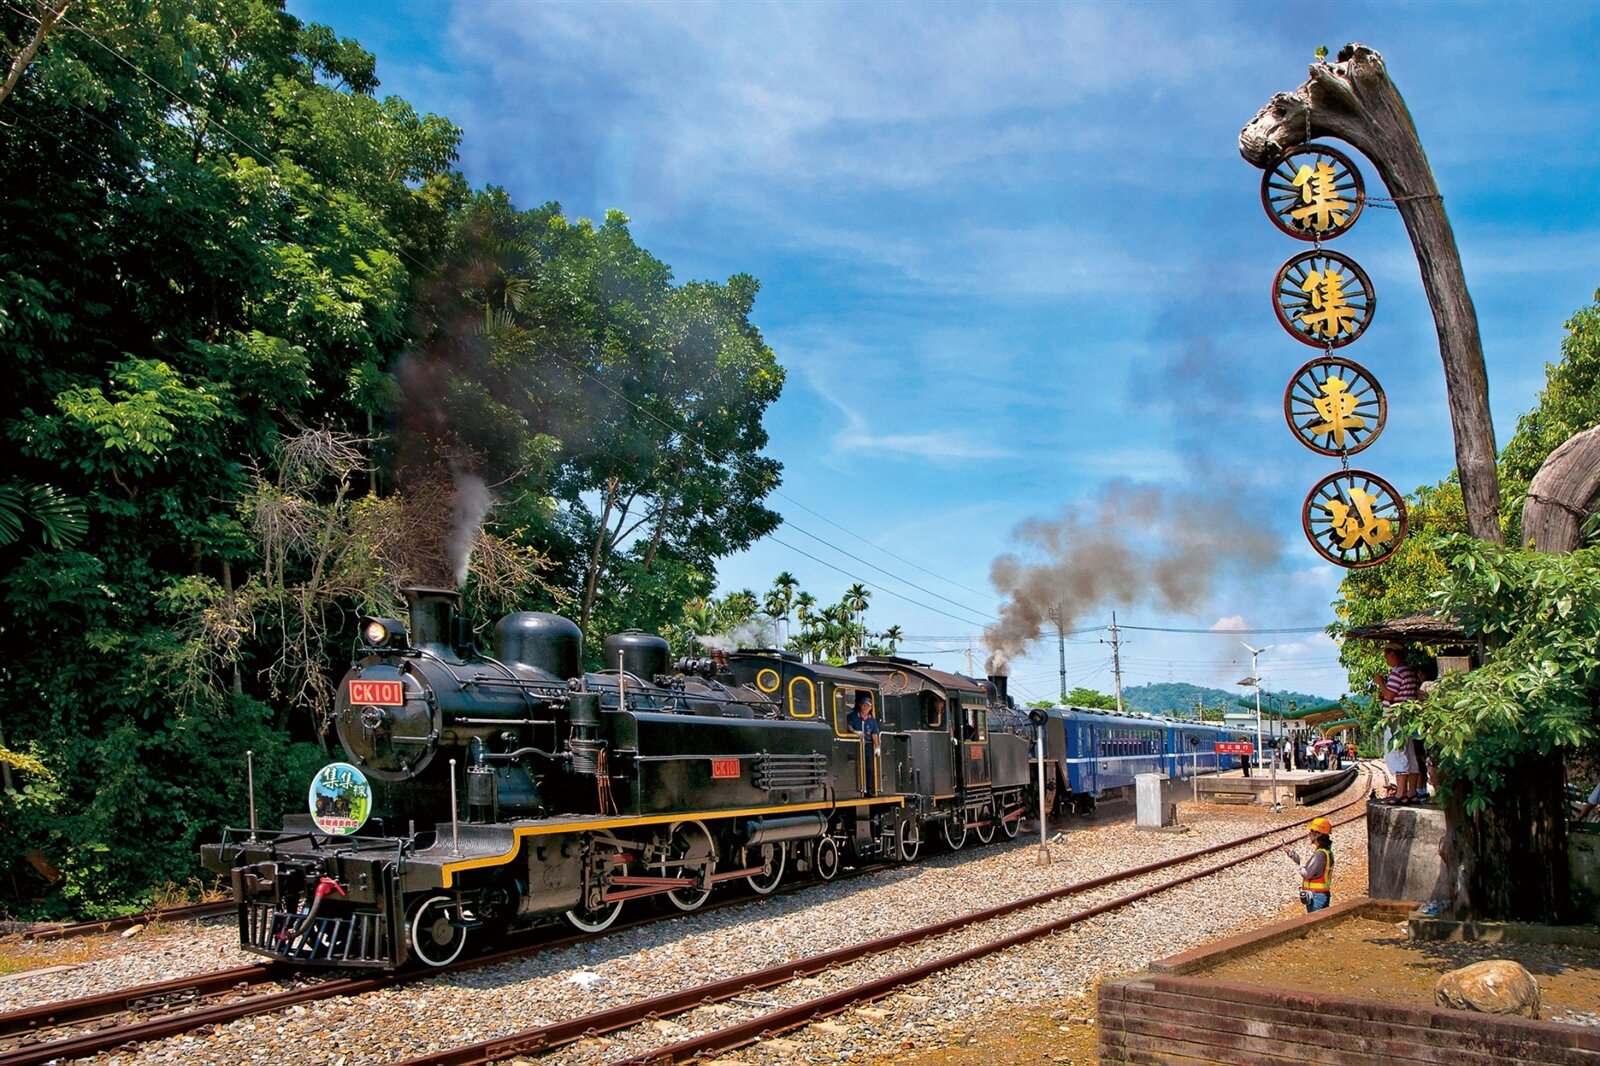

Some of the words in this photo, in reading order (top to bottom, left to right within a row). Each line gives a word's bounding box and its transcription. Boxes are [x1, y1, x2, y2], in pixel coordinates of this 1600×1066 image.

[1292, 161, 1392, 549] 集集車站
[353, 684, 399, 702] CK101
[714, 761, 738, 776] CK101
